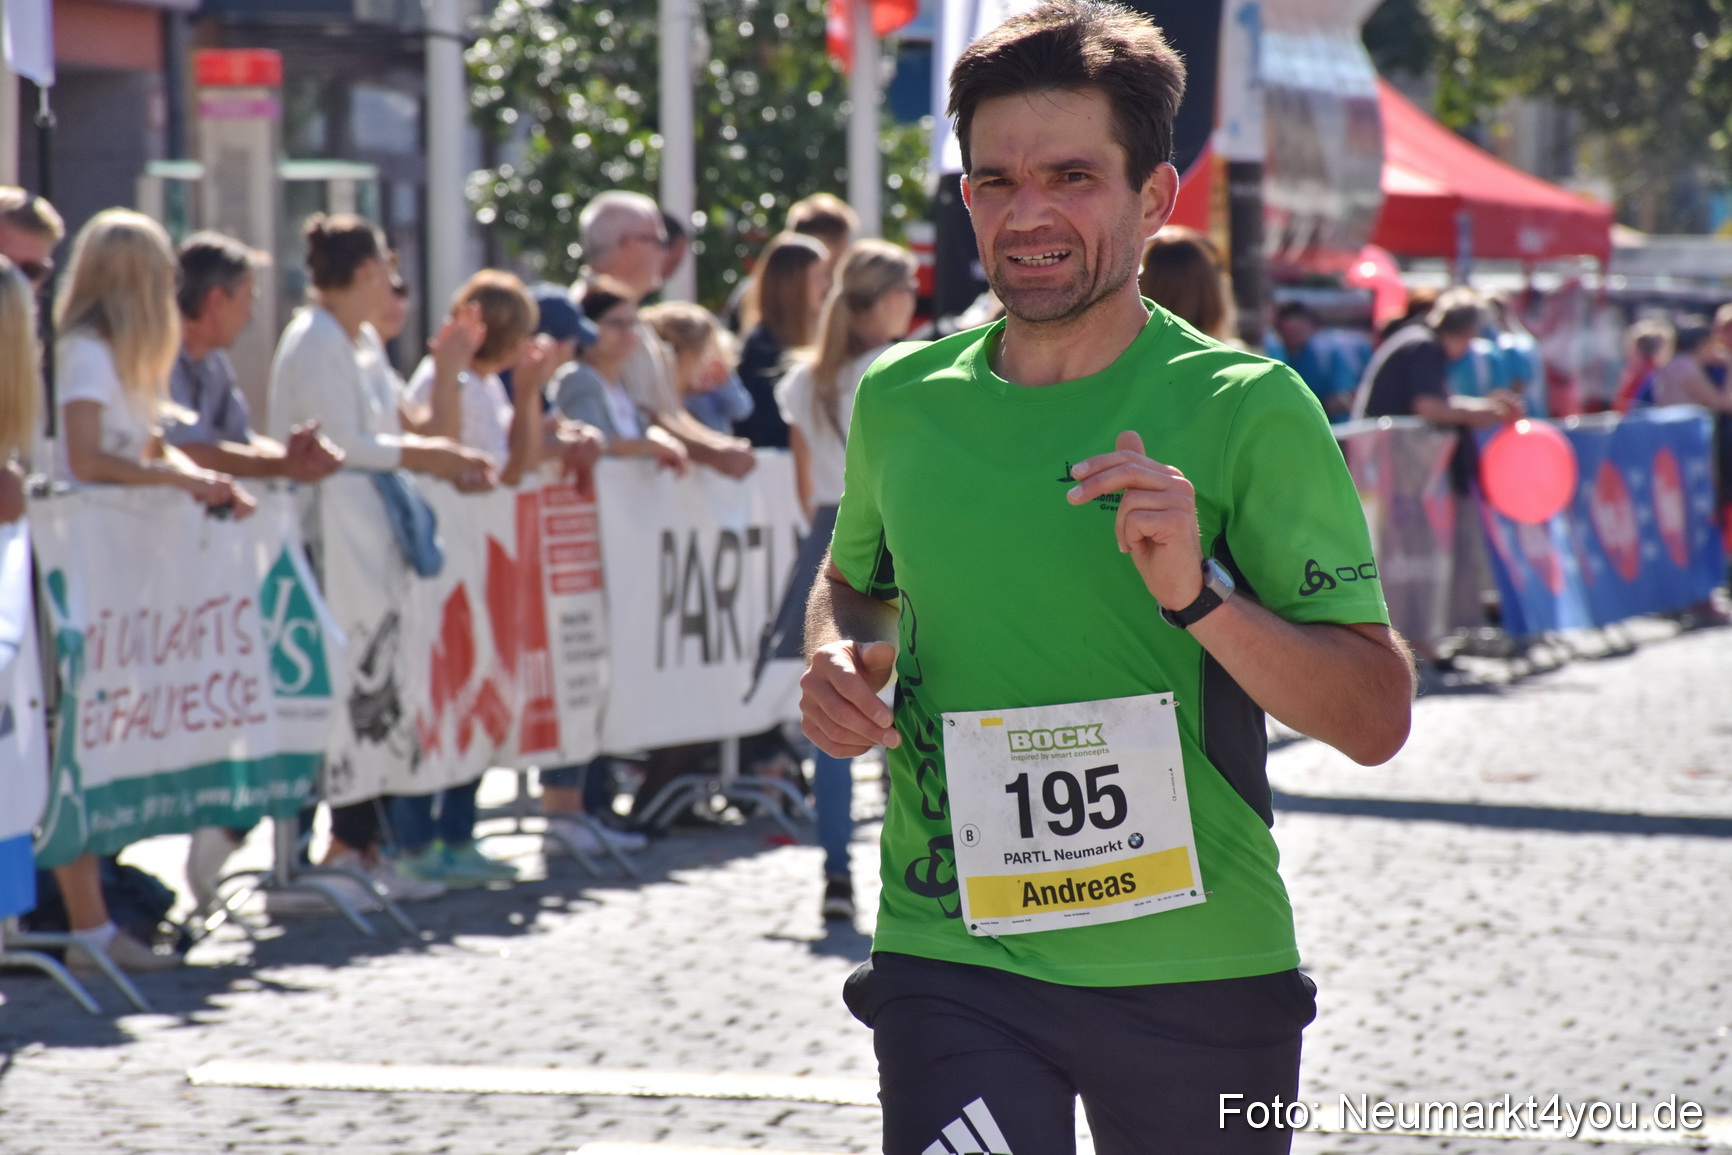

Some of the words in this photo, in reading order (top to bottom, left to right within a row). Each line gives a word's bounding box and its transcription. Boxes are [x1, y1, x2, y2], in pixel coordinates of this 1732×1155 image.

[1007, 723, 1107, 752] BOCK
[1011, 753, 1039, 762] inspired
[1041, 752, 1049, 761] by
[1050, 751, 1072, 759] smart
[1074, 747, 1110, 757] concepts
[1005, 763, 1128, 839] 195
[965, 829, 975, 842] B
[1003, 850, 1052, 865] PARTL
[1054, 839, 1123, 862] Neumarkt
[1022, 872, 1137, 908] Andreas
